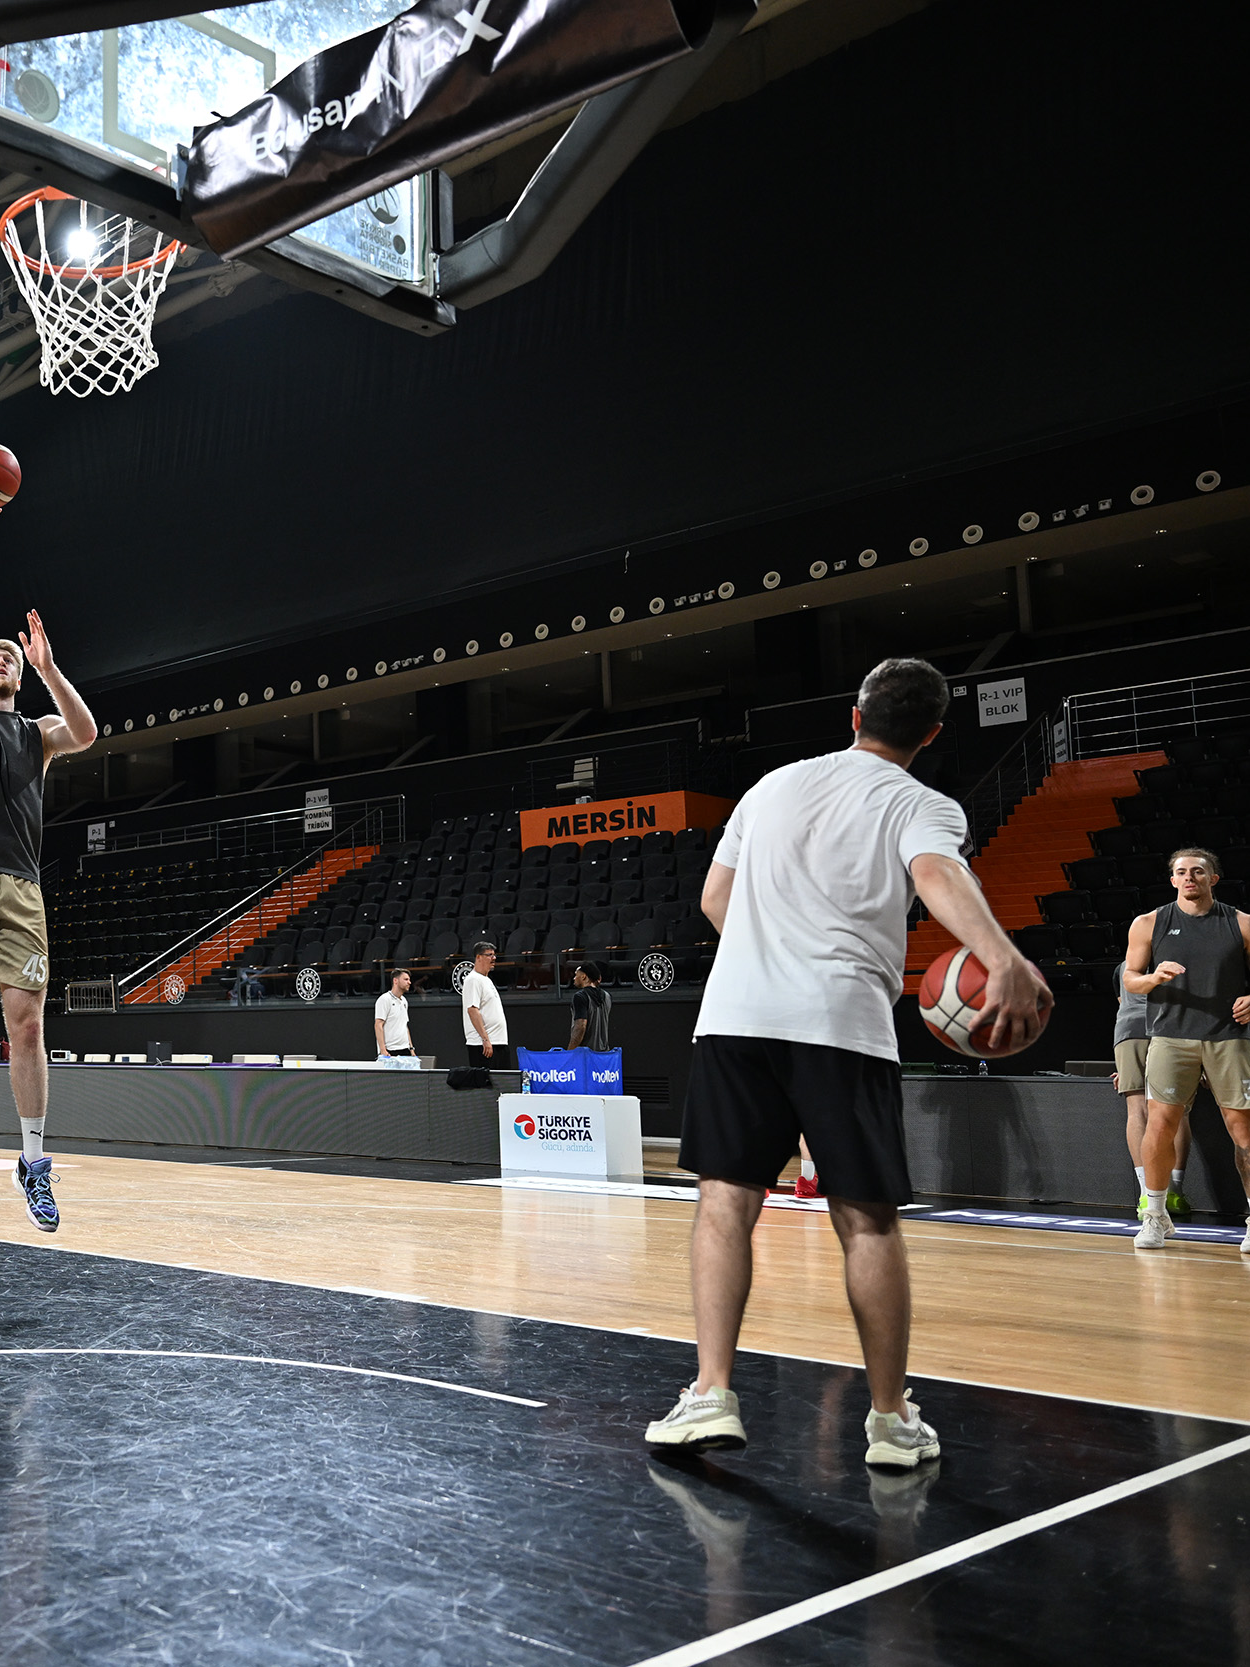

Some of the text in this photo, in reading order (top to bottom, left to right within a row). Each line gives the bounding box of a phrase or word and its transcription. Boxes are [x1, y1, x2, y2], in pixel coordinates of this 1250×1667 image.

[979, 687, 1023, 702] R-1 VIP
[985, 703, 1019, 717] BLOK
[547, 800, 656, 839] MERSİN
[528, 1069, 576, 1083] molten
